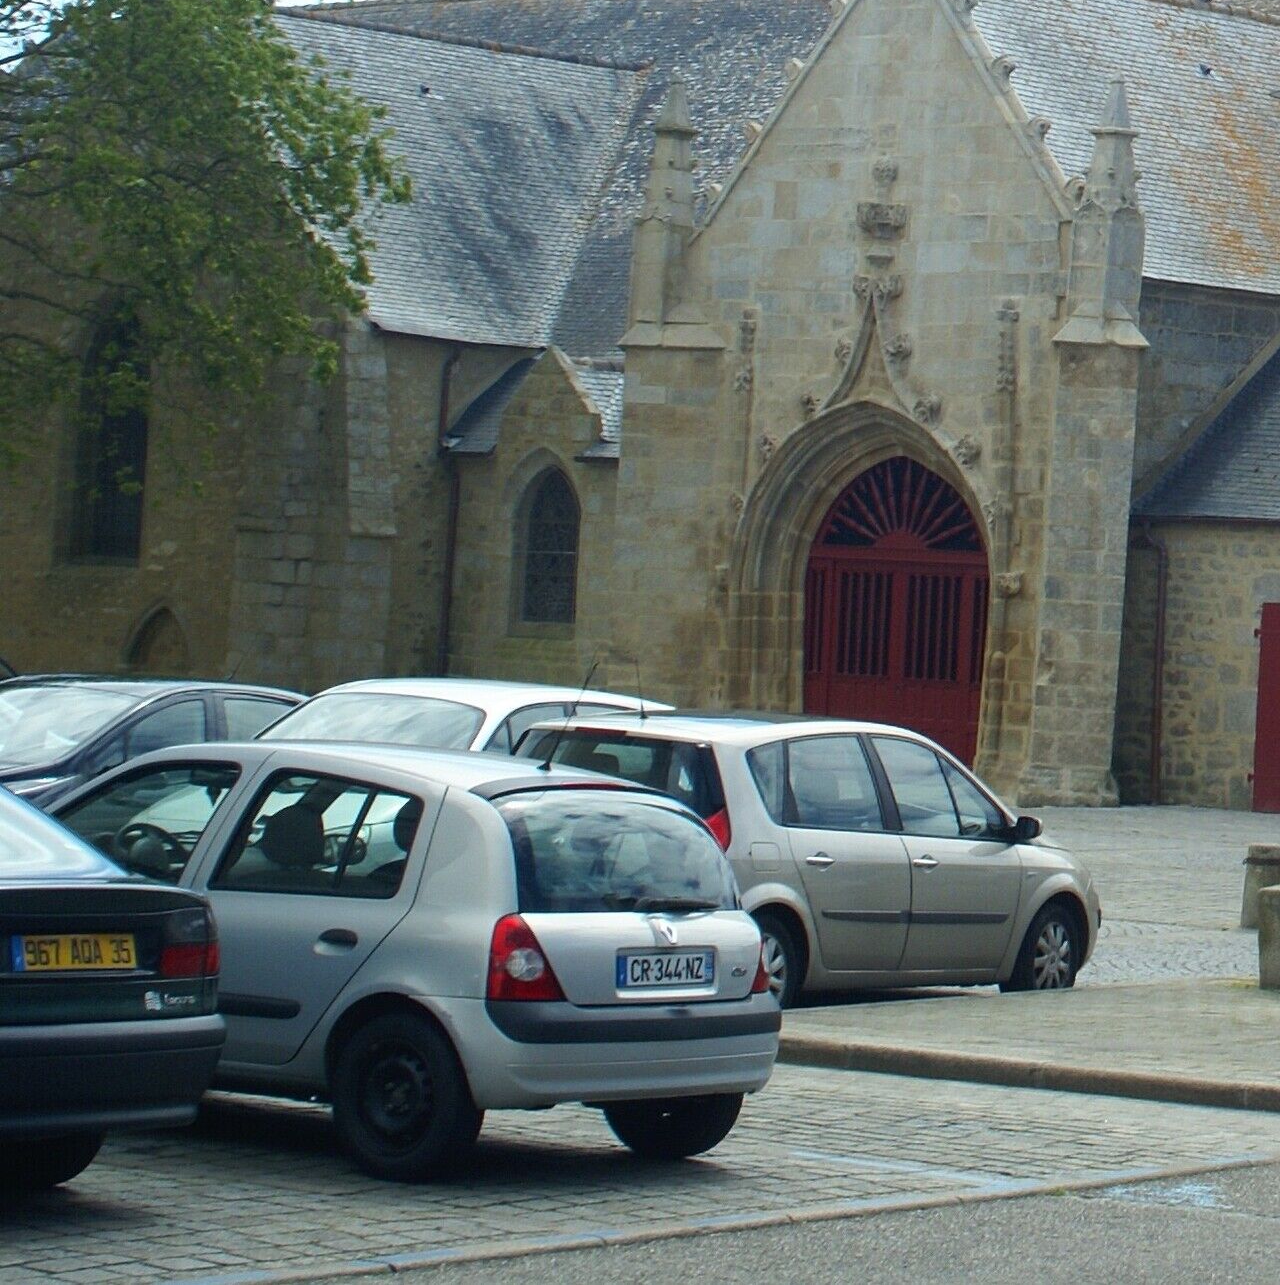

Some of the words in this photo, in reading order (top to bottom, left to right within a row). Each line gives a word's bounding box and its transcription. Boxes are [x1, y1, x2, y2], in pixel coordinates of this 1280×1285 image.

[25, 940, 60, 965] 967
[71, 939, 103, 964] AQA
[110, 939, 132, 964] 35
